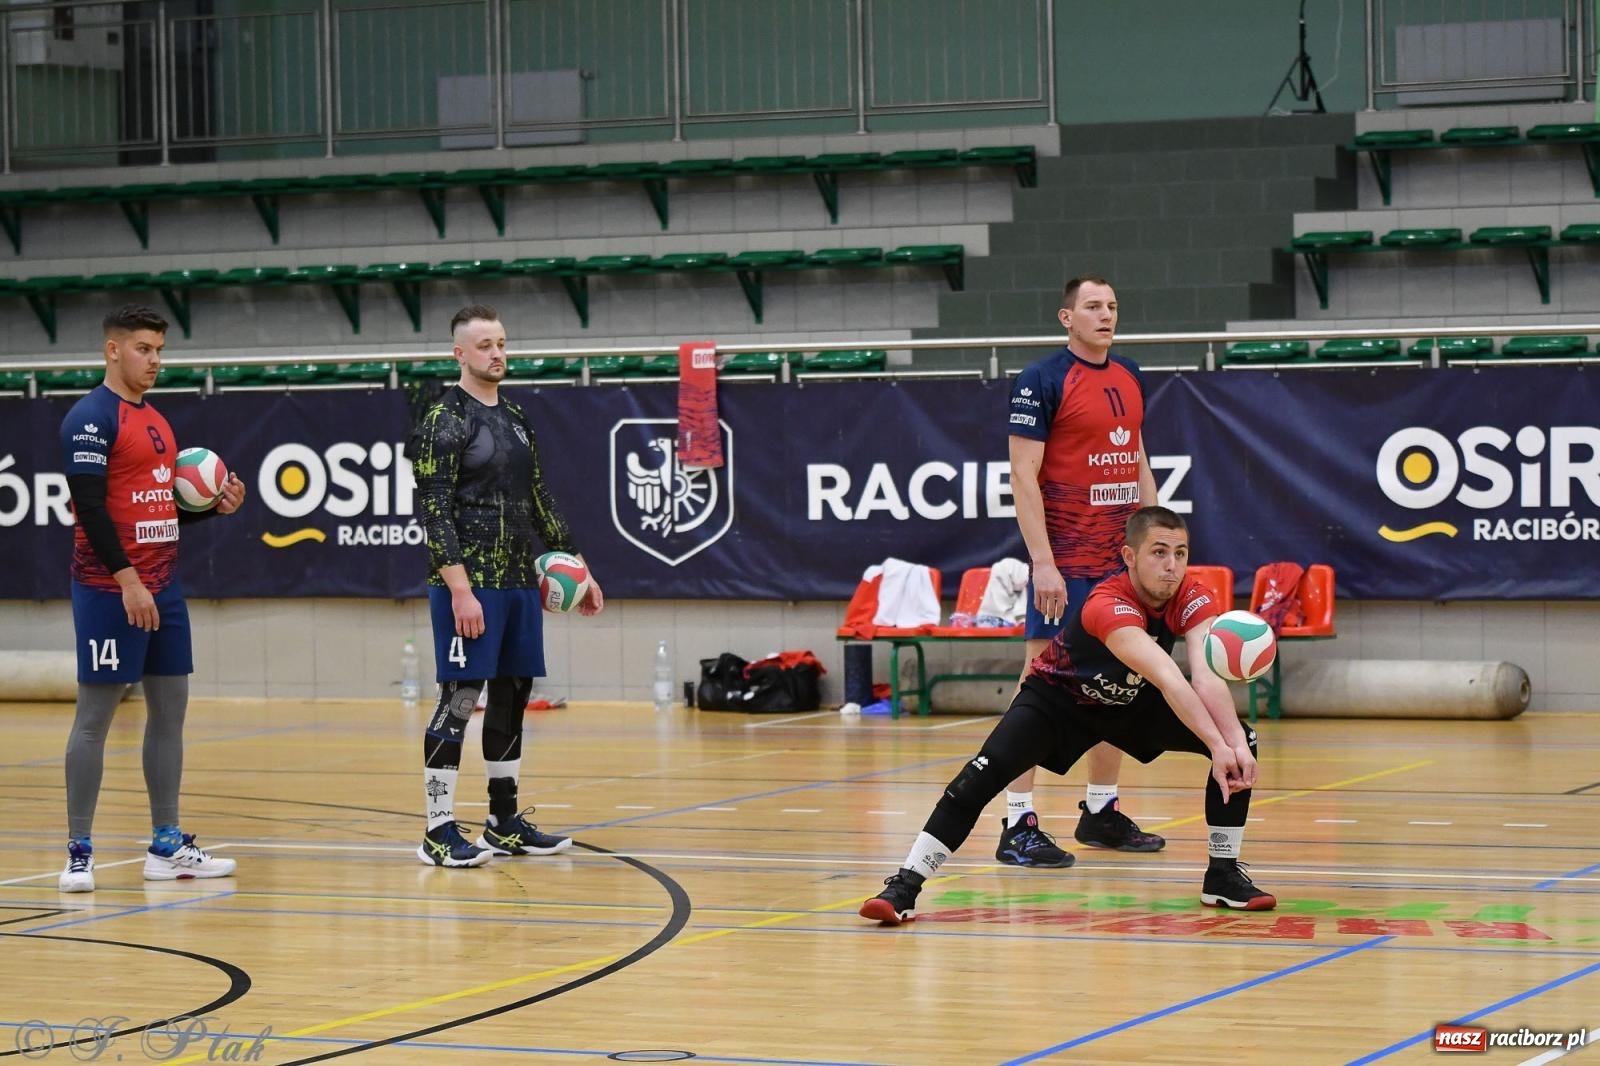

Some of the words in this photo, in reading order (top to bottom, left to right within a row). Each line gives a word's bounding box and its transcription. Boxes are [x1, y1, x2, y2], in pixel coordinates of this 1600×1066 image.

[1103, 387, 1126, 418] 11
[72, 434, 108, 447] KATOLIK
[147, 425, 167, 455] 8
[88, 638, 120, 672] 14
[448, 636, 467, 669] 4
